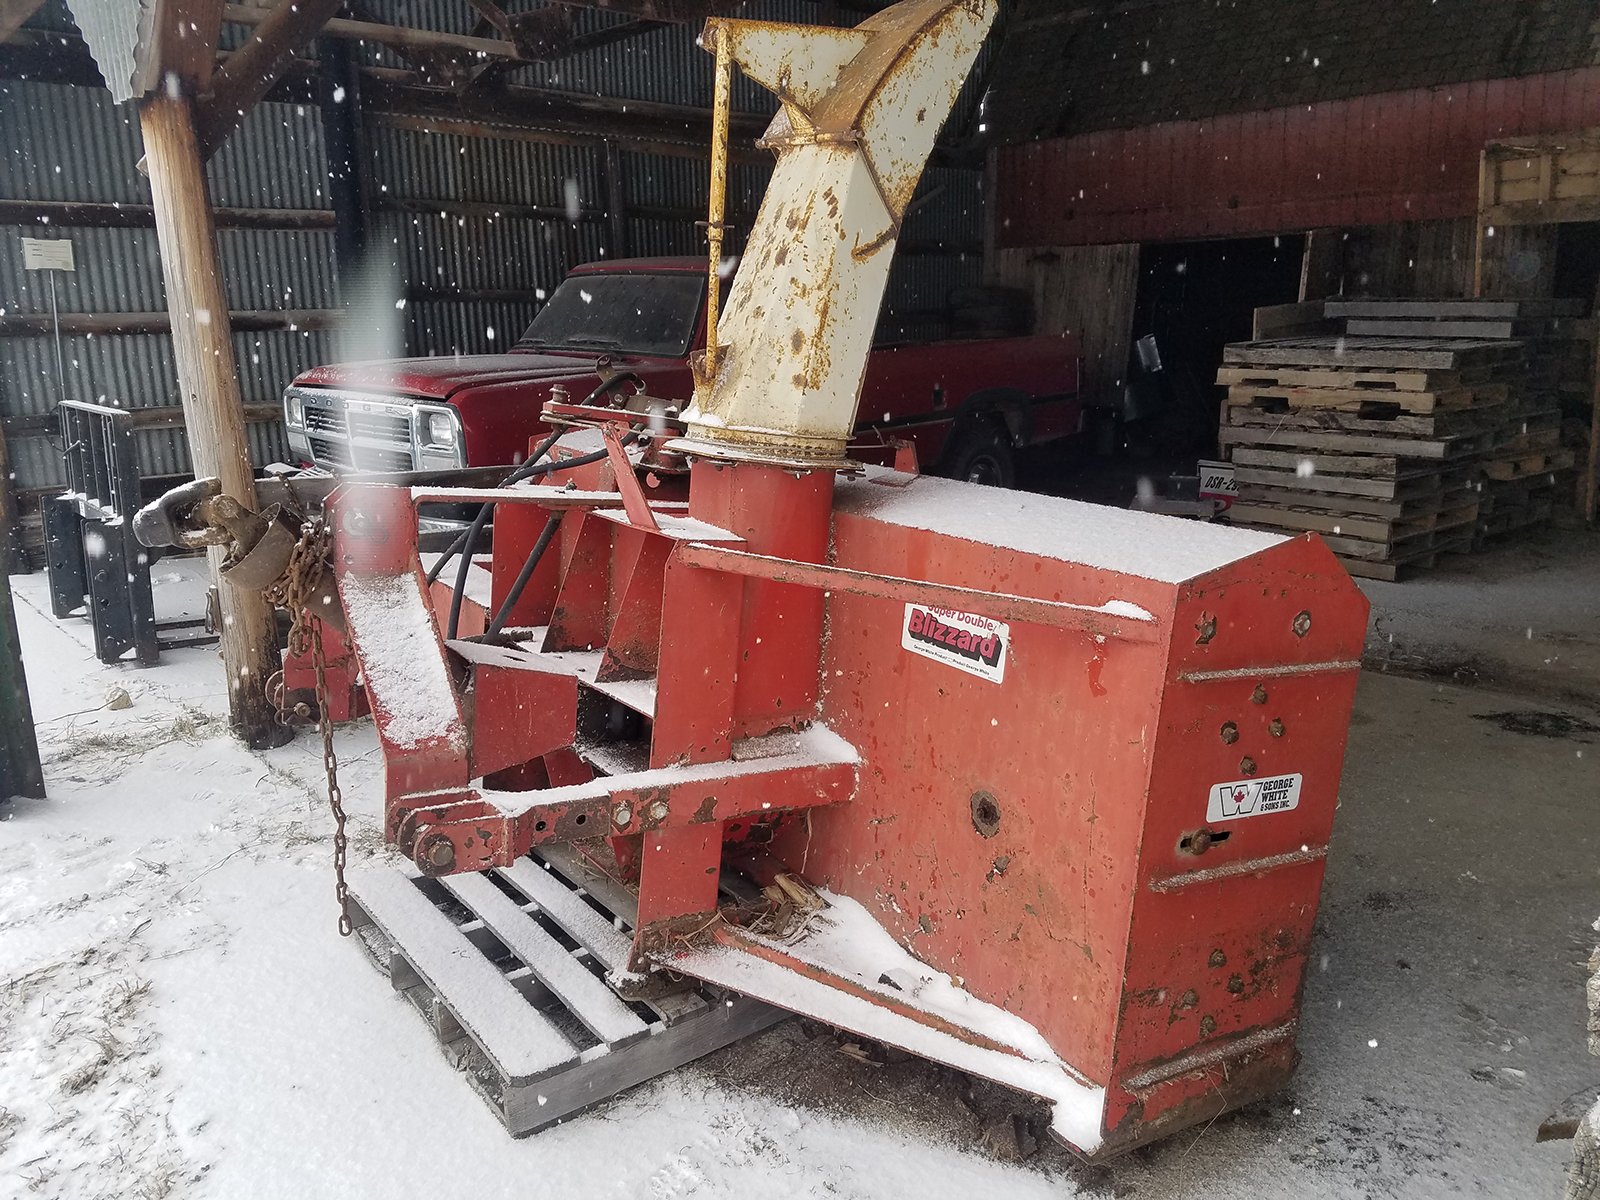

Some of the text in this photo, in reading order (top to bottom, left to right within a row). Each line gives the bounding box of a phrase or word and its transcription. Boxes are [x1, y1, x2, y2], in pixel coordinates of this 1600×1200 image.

[957, 611, 994, 632] Double
[908, 608, 1003, 668] Blizzard
[1263, 778, 1294, 792] GEORGE
[1261, 789, 1288, 803] WHITE
[1264, 801, 1280, 812] SONS
